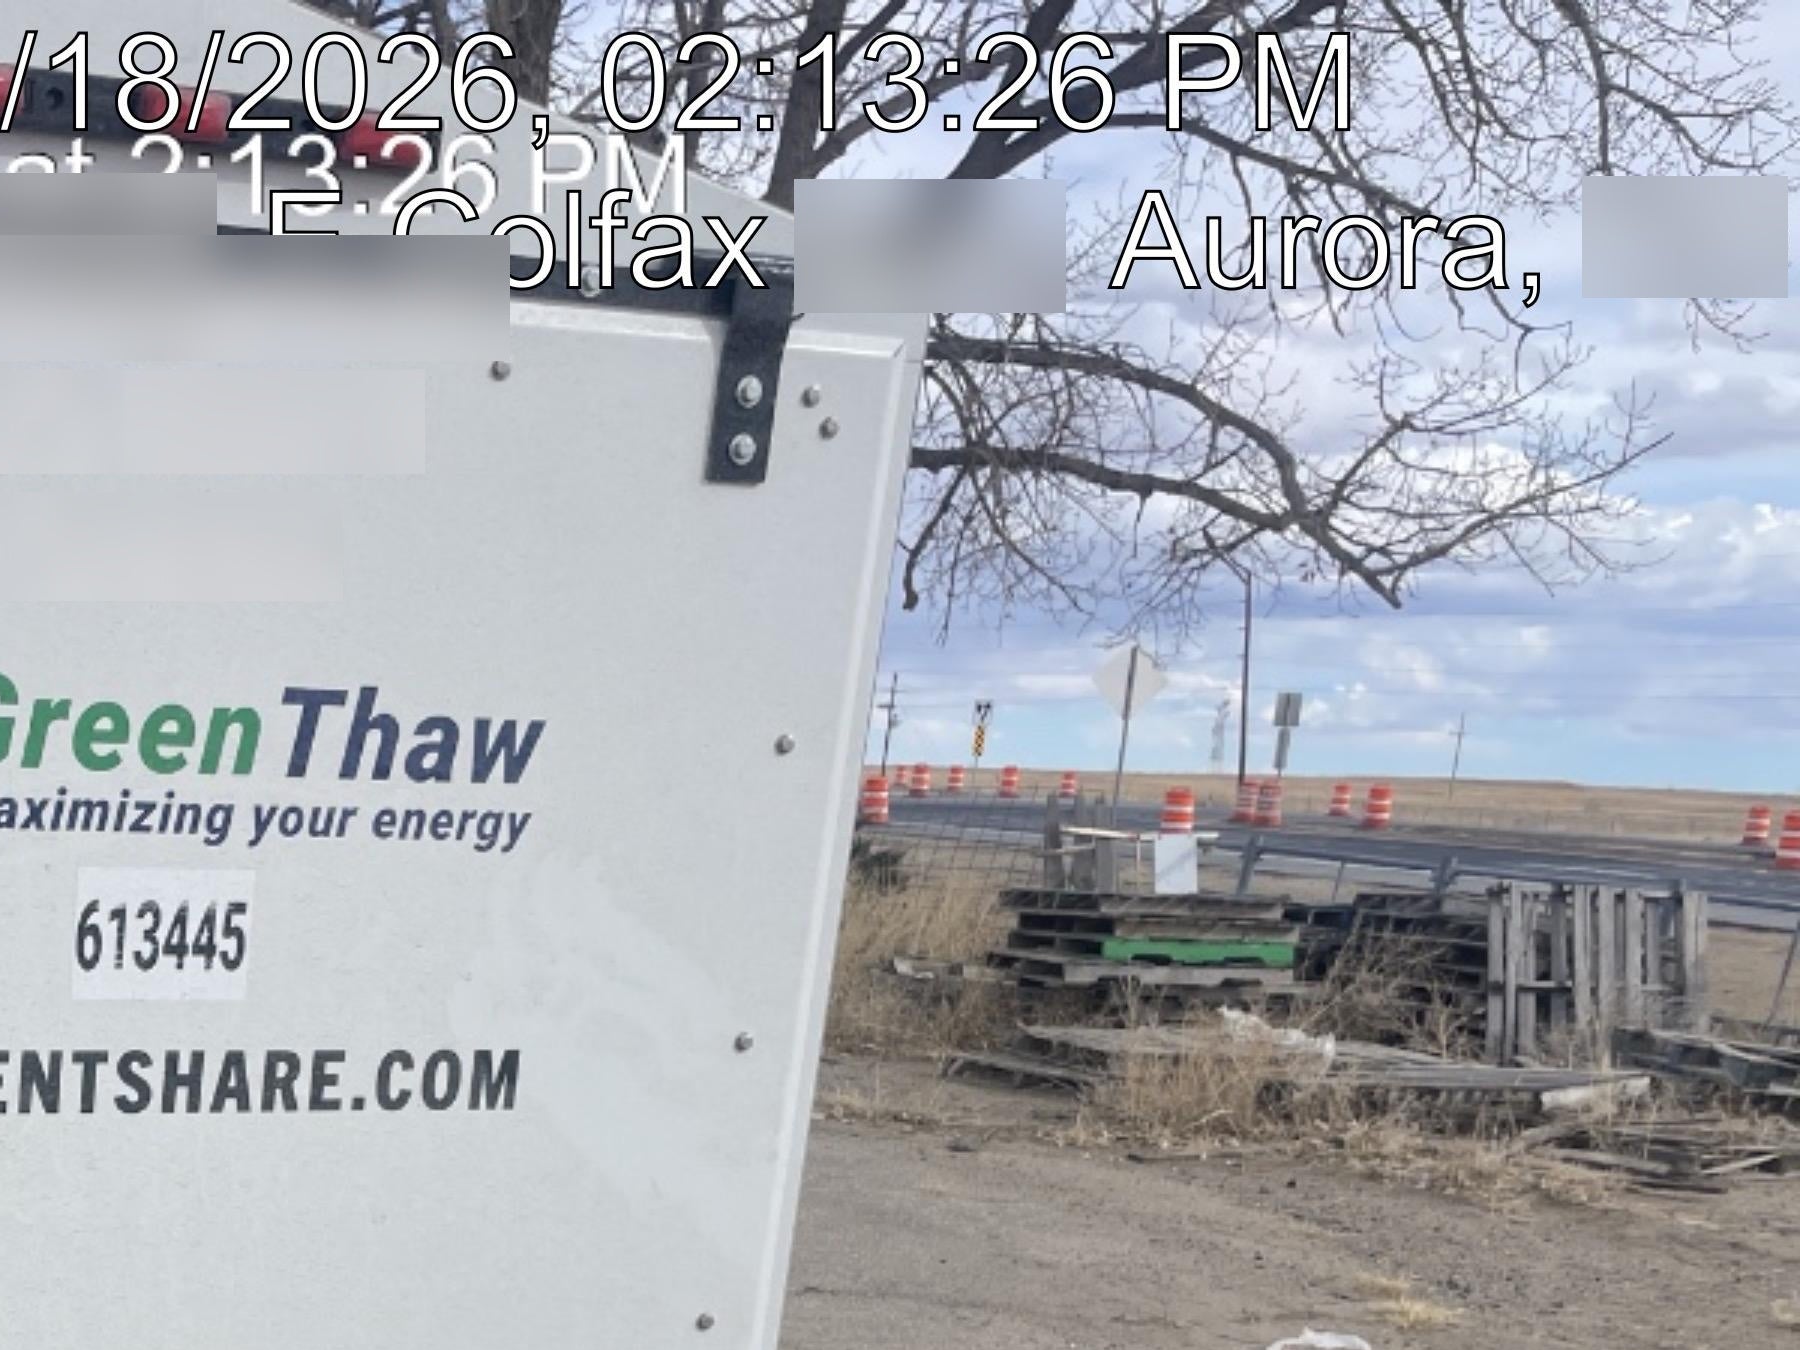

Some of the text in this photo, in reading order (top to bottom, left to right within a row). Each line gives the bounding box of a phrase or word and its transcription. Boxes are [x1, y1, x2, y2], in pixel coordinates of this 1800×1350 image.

[247, 803, 358, 846] your
[370, 806, 533, 853] energy
[75, 898, 249, 972] 613445
